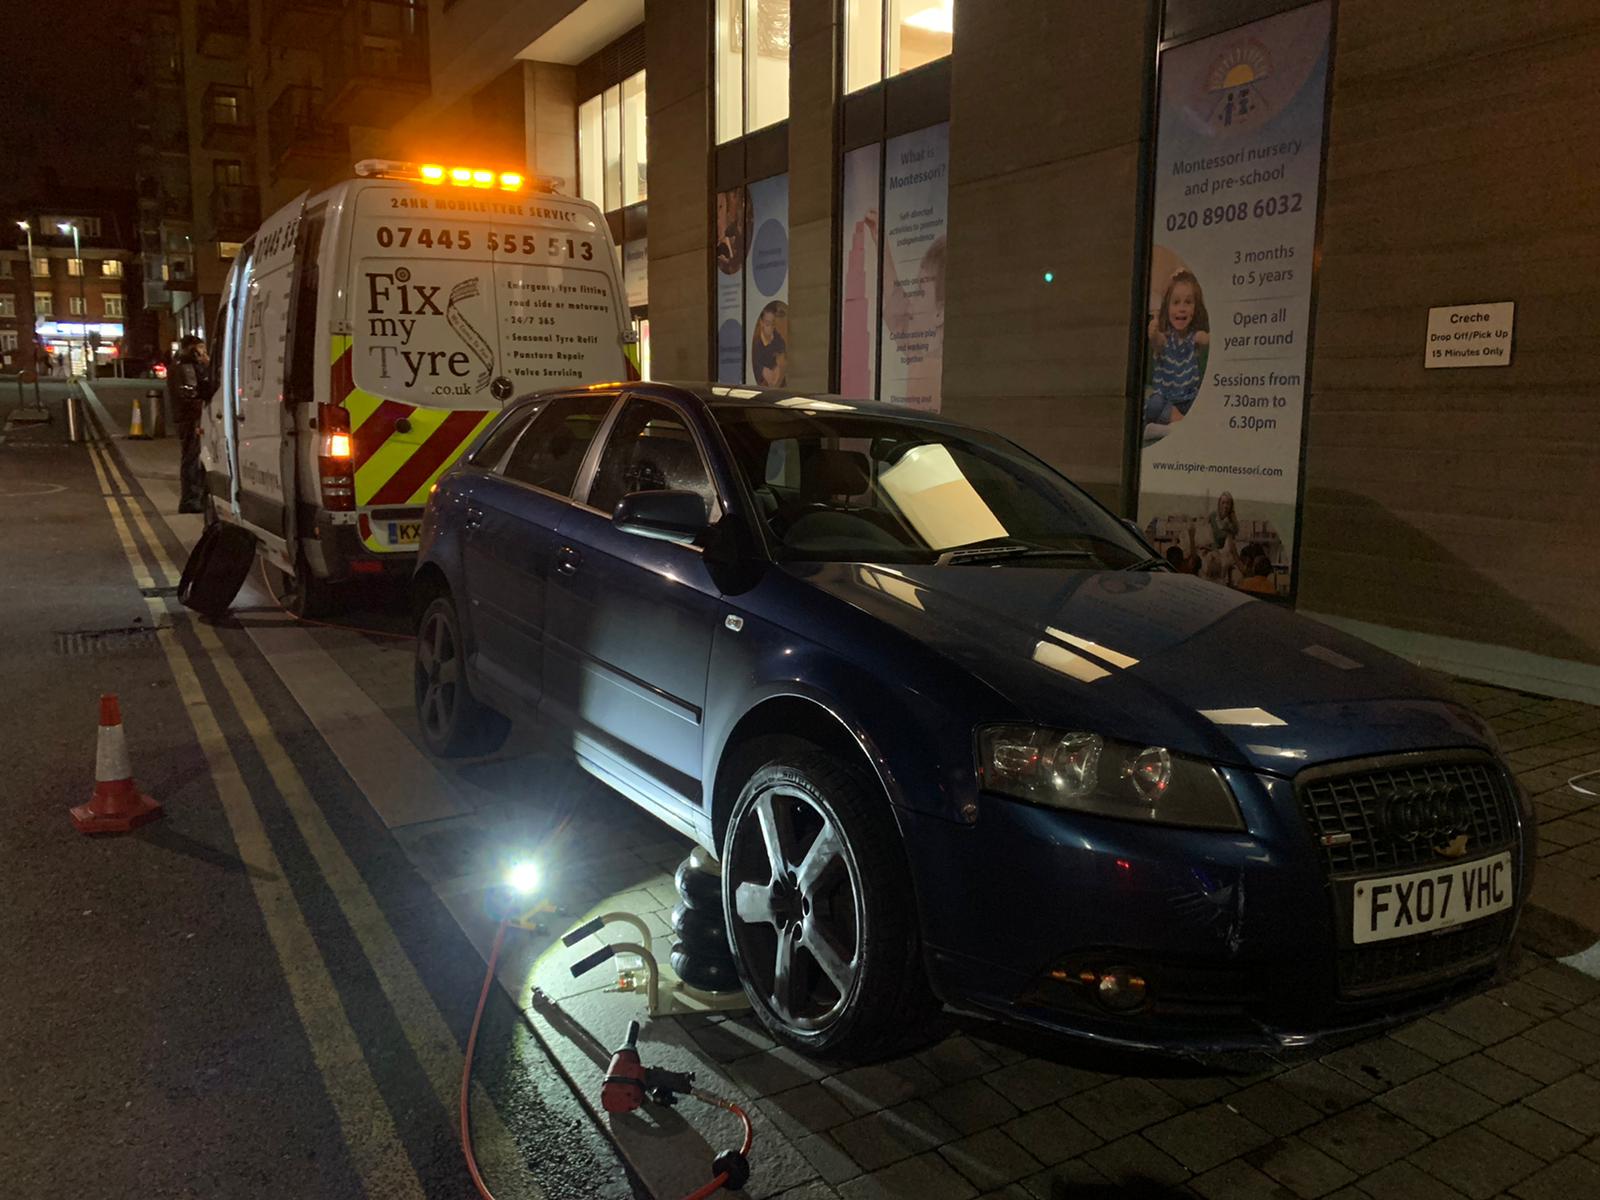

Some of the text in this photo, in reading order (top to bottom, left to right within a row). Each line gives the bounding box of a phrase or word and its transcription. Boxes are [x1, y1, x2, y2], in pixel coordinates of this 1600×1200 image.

[900, 144, 935, 165] What is
[1172, 138, 1303, 176] Montessori nursery
[889, 162, 946, 190] Montessori?
[1184, 164, 1286, 196] and pre-school
[391, 198, 428, 209] 24HR
[435, 199, 486, 213] MOBILE
[492, 202, 524, 215] TYRE
[1166, 193, 1303, 231] 020 8908 6032
[377, 226, 593, 260] 07445 555 513
[1234, 244, 1294, 264] 3 months
[1232, 269, 1294, 287] to 5 years
[365, 266, 443, 316] Fix
[509, 299, 530, 307] road
[534, 299, 552, 308] side
[568, 302, 609, 313] motorway
[511, 316, 534, 324] 24/7
[1233, 308, 1287, 328] Open all
[1450, 312, 1490, 324] Creche
[368, 317, 417, 345] my
[512, 333, 598, 344] Seasonal Tyre Refit
[1430, 330, 1509, 342] Drop Off/Pick Up
[1224, 330, 1294, 351] year round
[557, 351, 585, 362] Repair
[1432, 347, 1505, 358] 15 Minutes Only
[368, 346, 470, 388] Tyre
[514, 367, 583, 379] Valve Servicing
[1213, 371, 1300, 387] Sessions from
[431, 383, 471, 396] .co.uk
[1223, 394, 1286, 408] 7.30am to
[1229, 415, 1277, 432] 6.30pm
[1152, 461, 1283, 477] www.inspire-montessori.com
[1370, 861, 1504, 932] FX07 VHC
